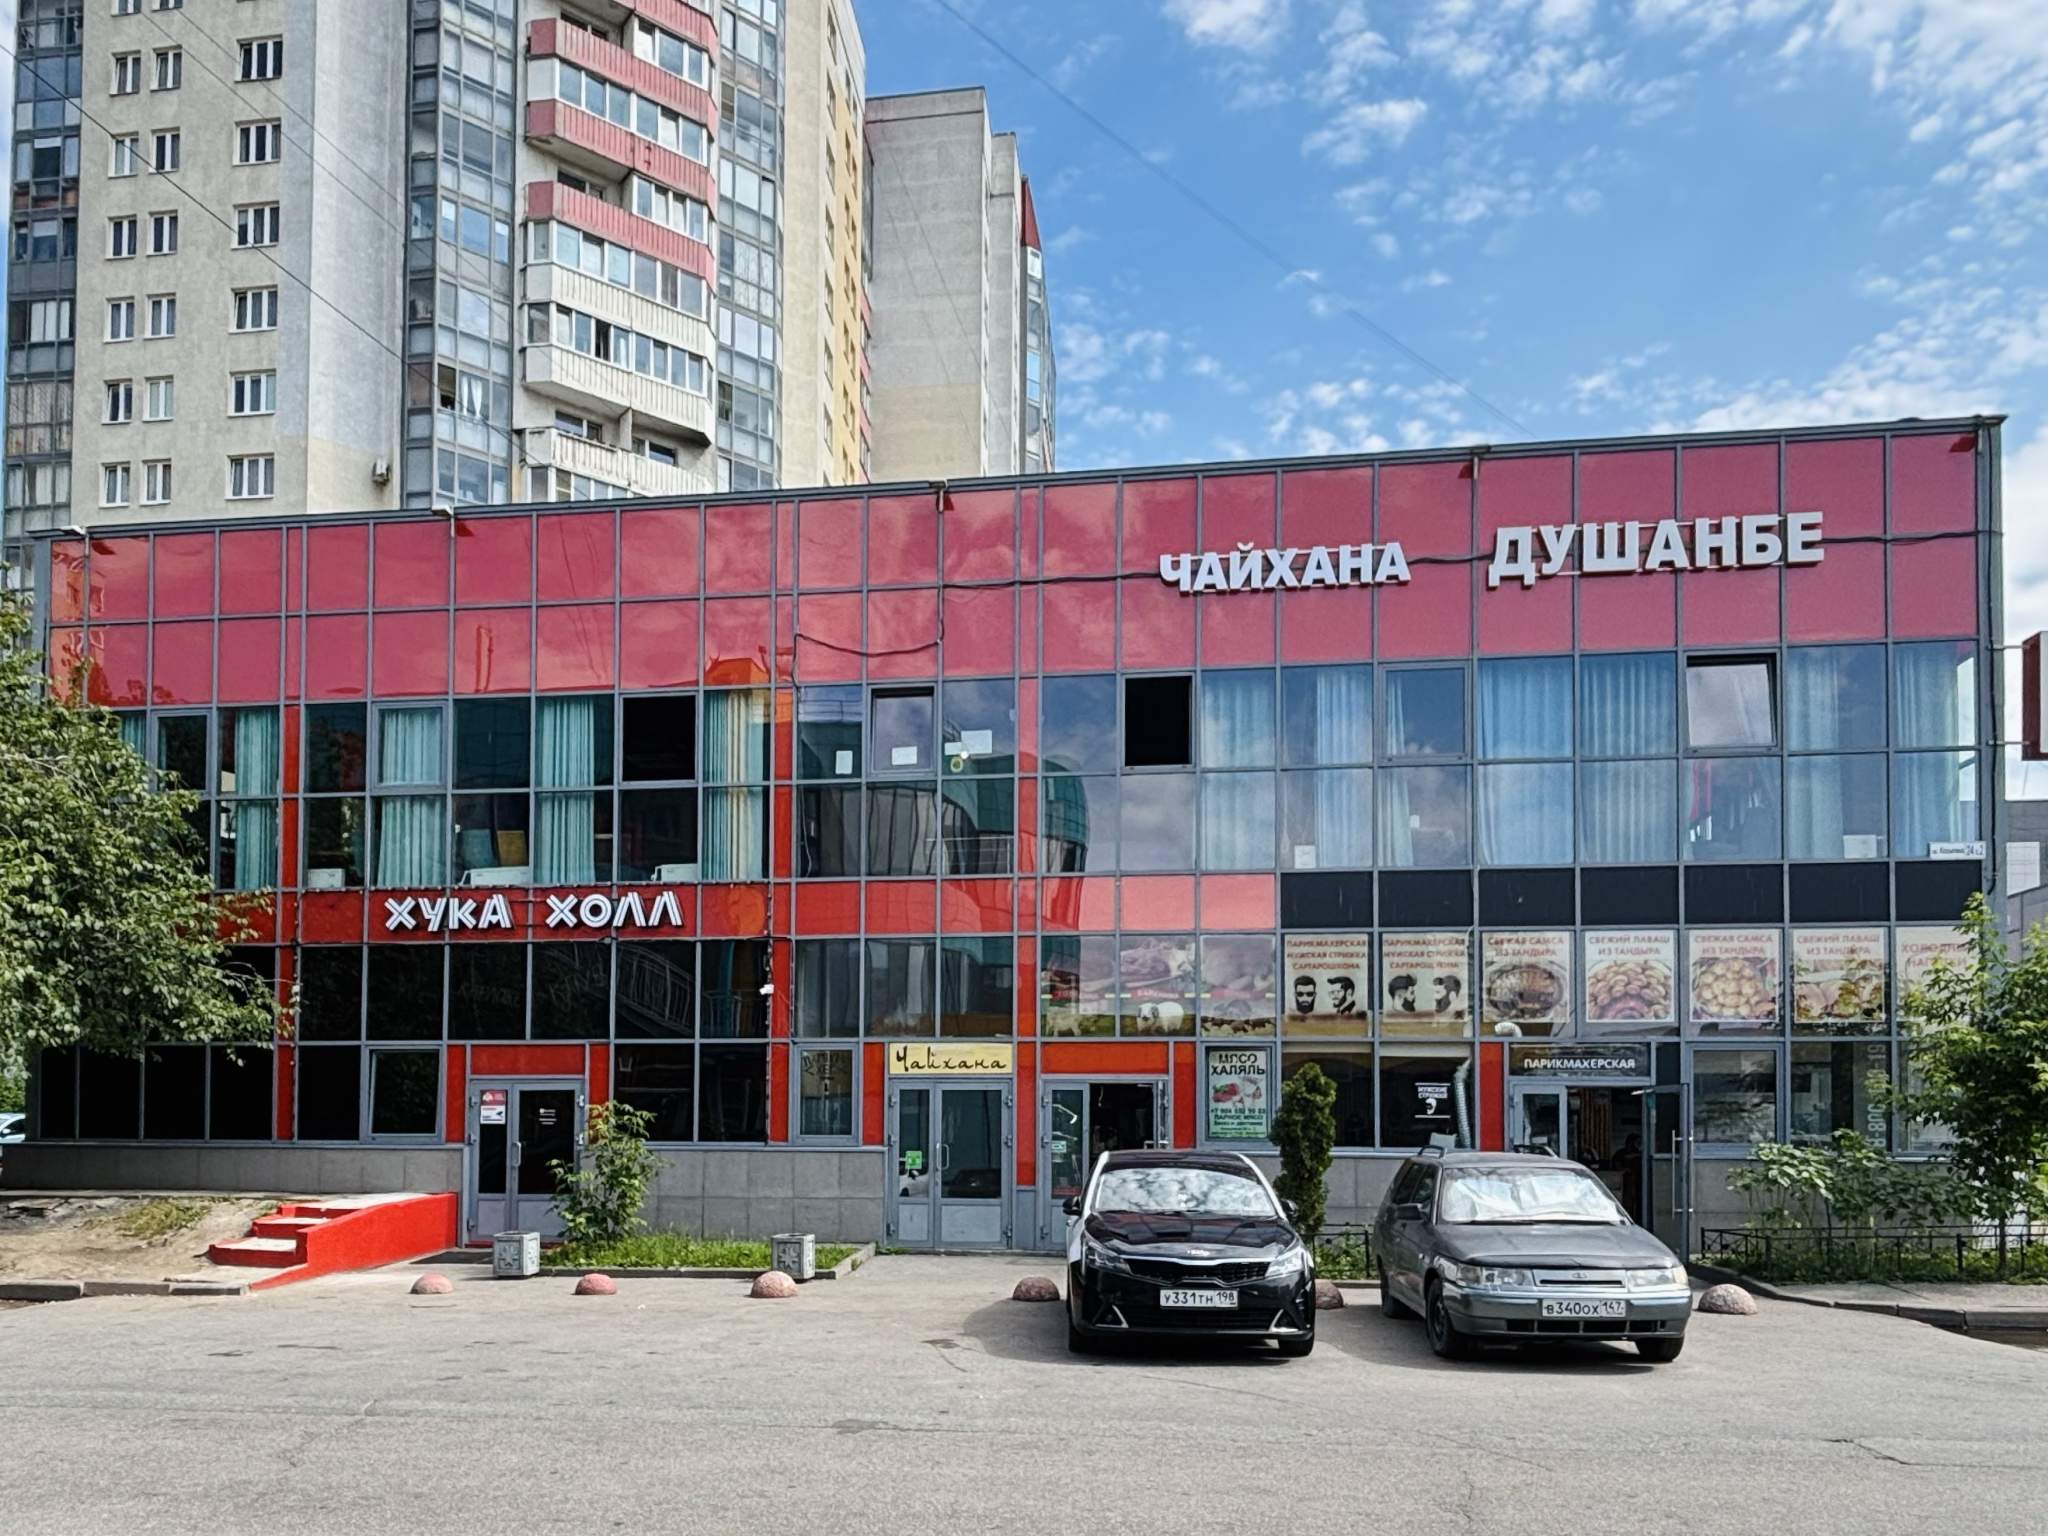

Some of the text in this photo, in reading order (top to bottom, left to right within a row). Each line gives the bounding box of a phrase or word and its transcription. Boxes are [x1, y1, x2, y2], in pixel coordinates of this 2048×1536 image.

[1488, 511, 1825, 588] ДУШАНБЕ
[1160, 541, 1411, 593] ЧАЙХАНА
[384, 891, 684, 932] ХУКА ХОЛЛ
[896, 1045, 1006, 1072] Чайхана
[1524, 1058, 1636, 1069] ПАРИКМАХЕРСКАЯ
[1211, 1065, 1265, 1075] ХАЛЯЛЬ
[1164, 1291, 1235, 1304] У331ТН 198
[1547, 1301, 1622, 1315] В340ОХ 147
